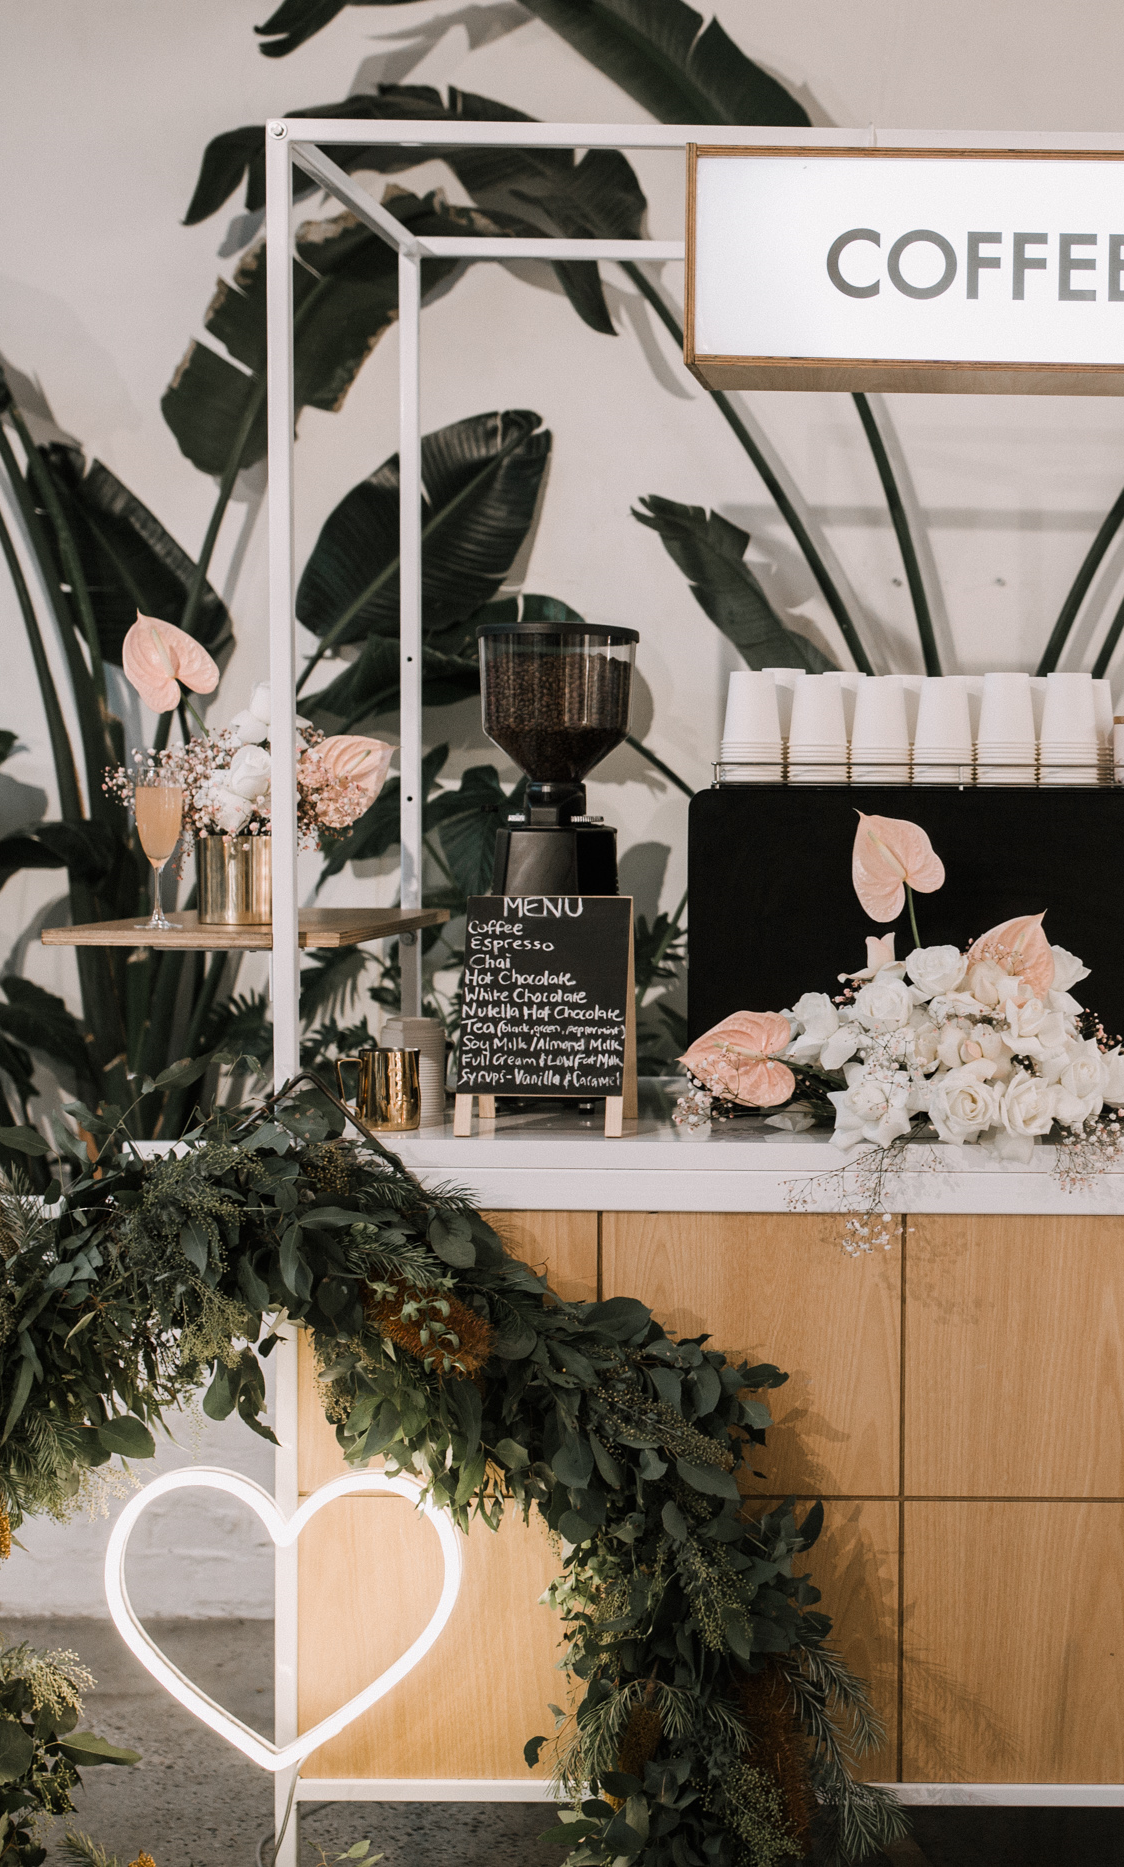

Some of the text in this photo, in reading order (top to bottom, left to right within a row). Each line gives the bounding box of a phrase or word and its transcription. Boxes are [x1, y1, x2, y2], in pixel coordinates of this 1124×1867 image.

[503, 897, 584, 918] MENU
[468, 920, 523, 935] Coffee
[470, 936, 555, 955] Espresso
[469, 953, 511, 969] Chai
[465, 969, 577, 986] Hot Chocolate
[464, 986, 587, 1003] White Chocolate
[462, 1003, 624, 1021] Nutella Hot Chocolate
[461, 1018, 495, 1034] Tea
[462, 1035, 490, 1055] Soy
[493, 1037, 528, 1051] Milk
[589, 1038, 624, 1051] Milk
[462, 1053, 489, 1066] Full
[492, 1053, 536, 1066] Cream
[574, 1053, 597, 1070] Fat
[597, 1053, 624, 1069] Milk
[573, 1071, 620, 1087] Caramel
